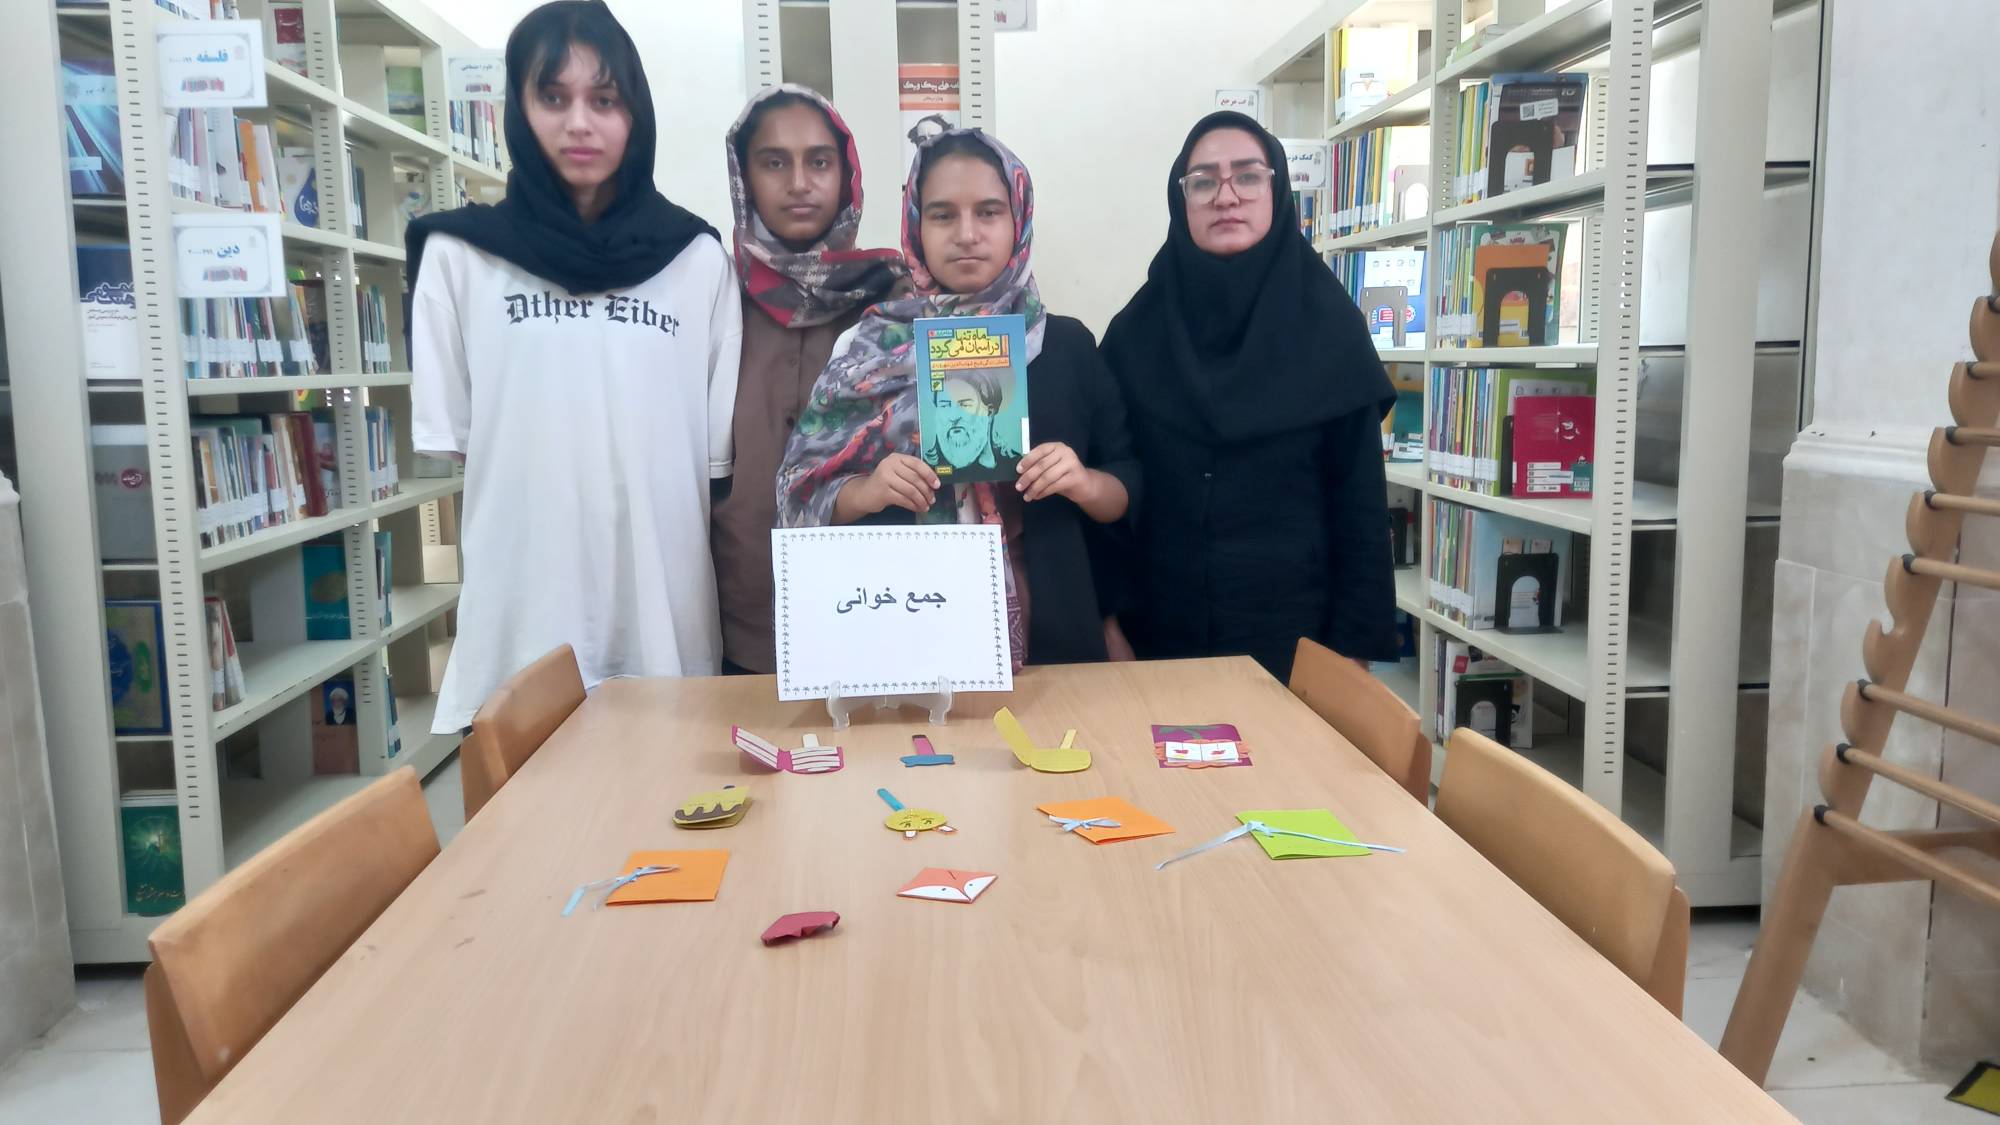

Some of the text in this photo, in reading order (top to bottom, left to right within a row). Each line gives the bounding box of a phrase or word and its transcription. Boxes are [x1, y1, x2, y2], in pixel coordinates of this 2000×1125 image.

[196, 48, 229, 63] فلسفه
[217, 244, 240, 259] دین
[955, 329, 972, 341] تنها
[972, 328, 987, 340] ماه
[965, 337, 991, 355] آسمان
[990, 342, 1000, 356] در
[836, 586, 947, 614] جمع خوانی
